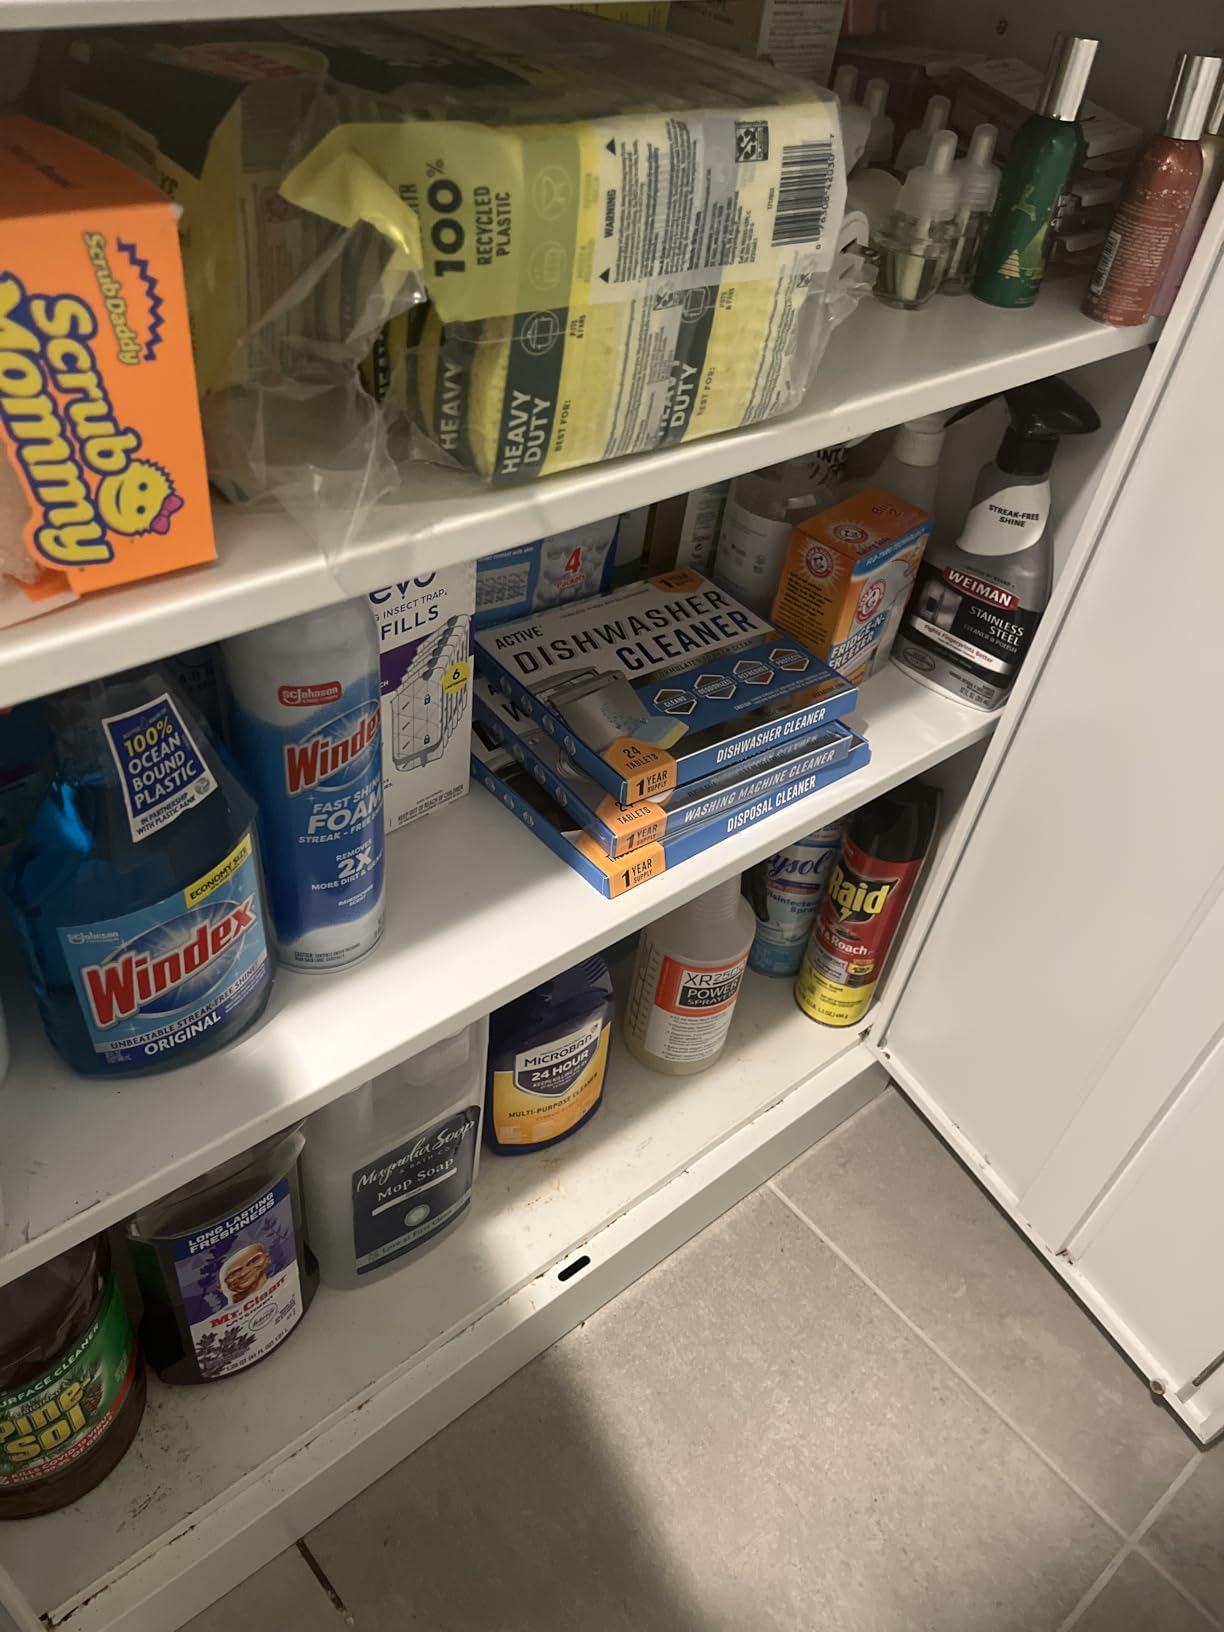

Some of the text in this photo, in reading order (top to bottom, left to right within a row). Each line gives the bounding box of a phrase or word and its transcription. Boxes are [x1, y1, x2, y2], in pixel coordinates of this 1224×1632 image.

[473, 186, 494, 266] RECYCLED
[496, 192, 512, 257] PLASTIC
[604, 189, 617, 239] WARNING
[83, 231, 142, 365] Scrub Daddy
[29, 293, 142, 477] Scrub
[669, 363, 698, 427] DUTY
[0, 271, 115, 567] Mommy
[440, 362, 464, 450] HEAVY
[500, 390, 531, 474] HEAVY
[524, 397, 551, 464] DUTY
[989, 504, 1040, 521] STREAK-FREE
[999, 516, 1025, 528] SHINE
[564, 546, 583, 574] 4
[948, 570, 1012, 607] WEIMAN
[381, 605, 439, 640] FILLS
[383, 598, 419, 619] INSECT
[969, 606, 1025, 636] STAINLESS
[496, 624, 544, 650] ACTIVE
[512, 590, 731, 674] DISHWASHER
[615, 610, 758, 672] CLEANER
[989, 626, 1020, 647] STEEL
[452, 668, 460, 680] 6
[124, 716, 173, 757] 100%
[128, 732, 181, 774] OCEAN
[284, 706, 382, 796] Winde
[622, 746, 641, 759] 24
[716, 727, 781, 764] DISHWASHER
[783, 708, 826, 737] CLEANER
[132, 751, 185, 791] BOUND
[625, 753, 659, 770] TABLETS
[647, 770, 668, 785] YEAR
[134, 760, 197, 809] PLASTIC
[313, 796, 351, 815] FAST
[353, 771, 381, 803] SHIN
[636, 779, 646, 796] 1
[647, 781, 667, 794] SUPPLY
[684, 793, 735, 823] WASHING
[738, 770, 786, 799] MACHINE
[788, 750, 836, 778] CLEANER
[150, 792, 189, 821] PARTNERSHIP
[307, 783, 382, 835] FOAM
[615, 800, 633, 812] 24
[617, 807, 651, 825] TABLETS
[727, 775, 817, 831] DISPOSAL CLEANER
[136, 821, 154, 836] WITH
[155, 808, 180, 826] PLASTIC
[299, 832, 342, 844] STREAK
[635, 824, 658, 839] YEAR
[636, 834, 656, 845] SUPPLY
[336, 838, 373, 862] REMOVES
[626, 834, 634, 849] 1
[190, 863, 233, 900] ECONOMY
[337, 847, 372, 880] 2X
[622, 869, 631, 888] 1
[631, 859, 652, 874] YEAR
[633, 869, 652, 883] SUPPLY
[768, 850, 832, 877] ysol
[311, 880, 340, 891] MORE
[341, 873, 359, 886] DIRT
[828, 867, 892, 914] Raid
[83, 895, 256, 1029] Windex
[831, 936, 868, 955] Roach
[687, 979, 738, 999] POWER
[687, 990, 735, 1005] SPRAYER
[111, 1025, 175, 1049] UNBEATABLE
[177, 986, 234, 1029] STREAK-FREE
[144, 1011, 222, 1057] ORIGINAL
[531, 1070, 550, 1082] 24
[552, 1050, 589, 1076] HOUR
[508, 1096, 571, 1119] MULTI-PURPOSE
[356, 1120, 475, 1192] Magnolia Soap
[377, 1158, 455, 1202] Mop Soap
[189, 1191, 274, 1247] LONG LASTING
[190, 1199, 275, 1254] FRESHNESS
[209, 1308, 243, 1328] Mr.
[244, 1274, 288, 1311] Clean
[0, 1322, 99, 1408] URFACE CLEANER
